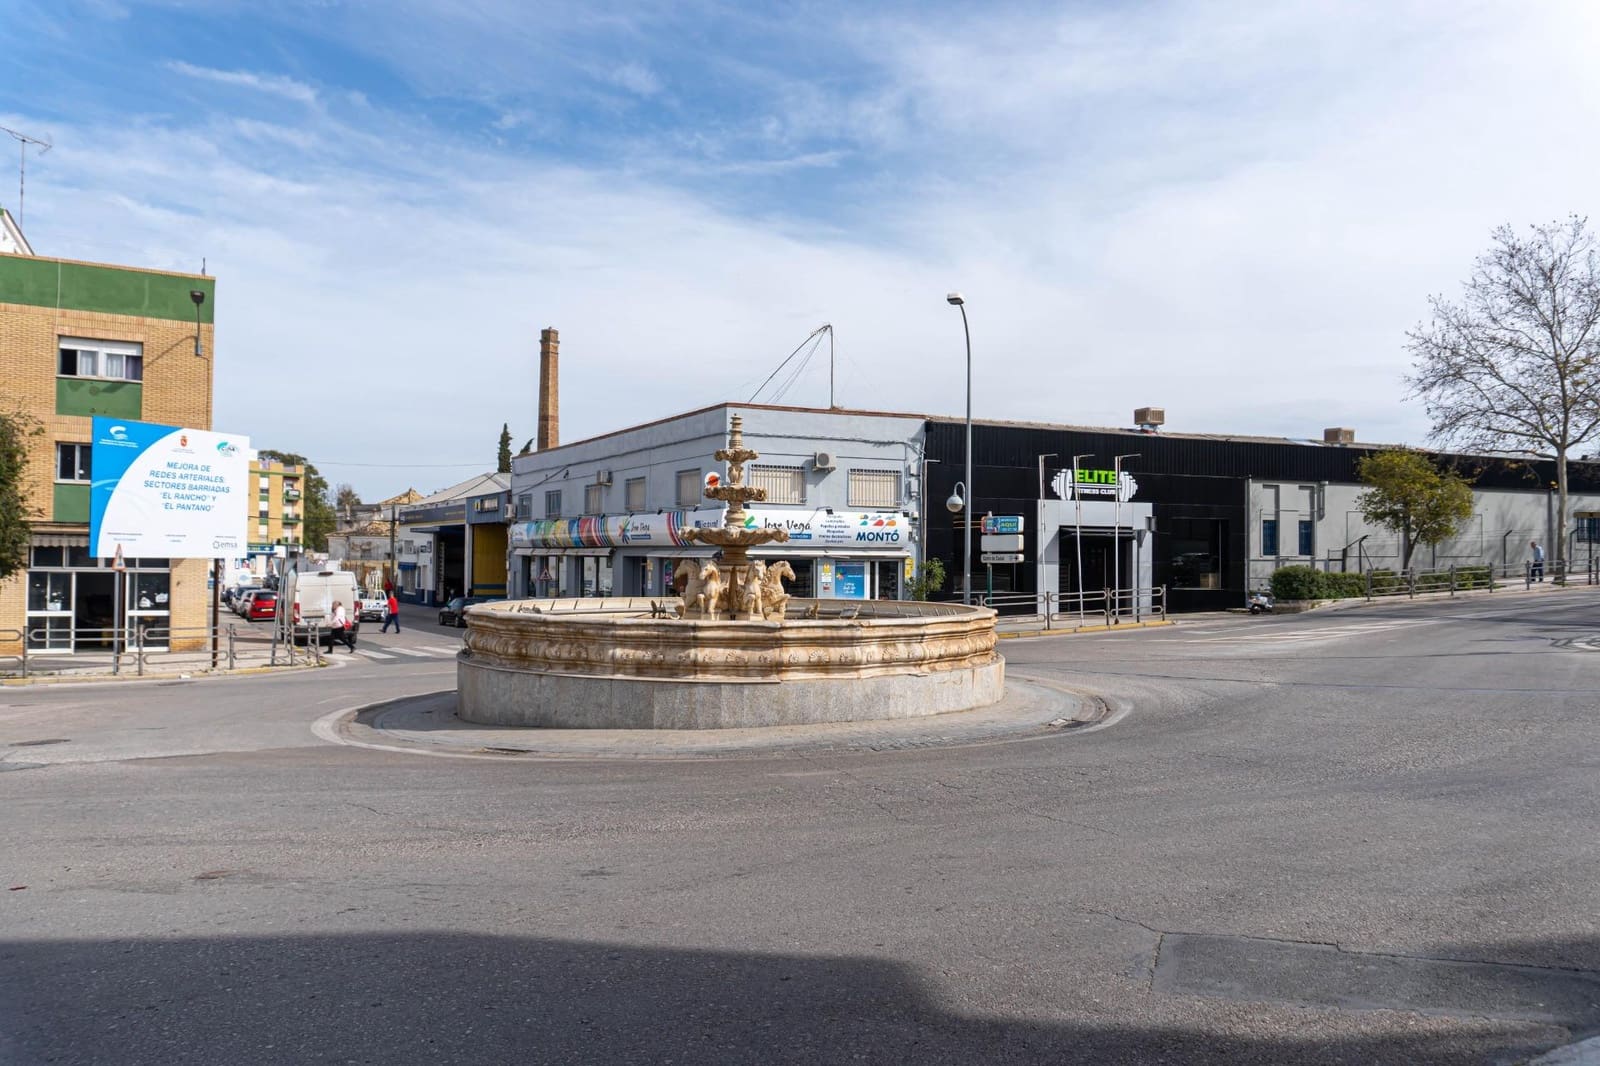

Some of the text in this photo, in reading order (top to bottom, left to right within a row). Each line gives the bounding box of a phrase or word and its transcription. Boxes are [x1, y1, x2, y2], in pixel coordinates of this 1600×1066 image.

[166, 462, 211, 472] MEJORA DE
[149, 470, 177, 479] REDES
[1076, 469, 1116, 483] ELITE
[143, 480, 230, 493] SECTORES BARRIADAS
[786, 520, 811, 530] Vega
[855, 529, 900, 541] MONTÓ
